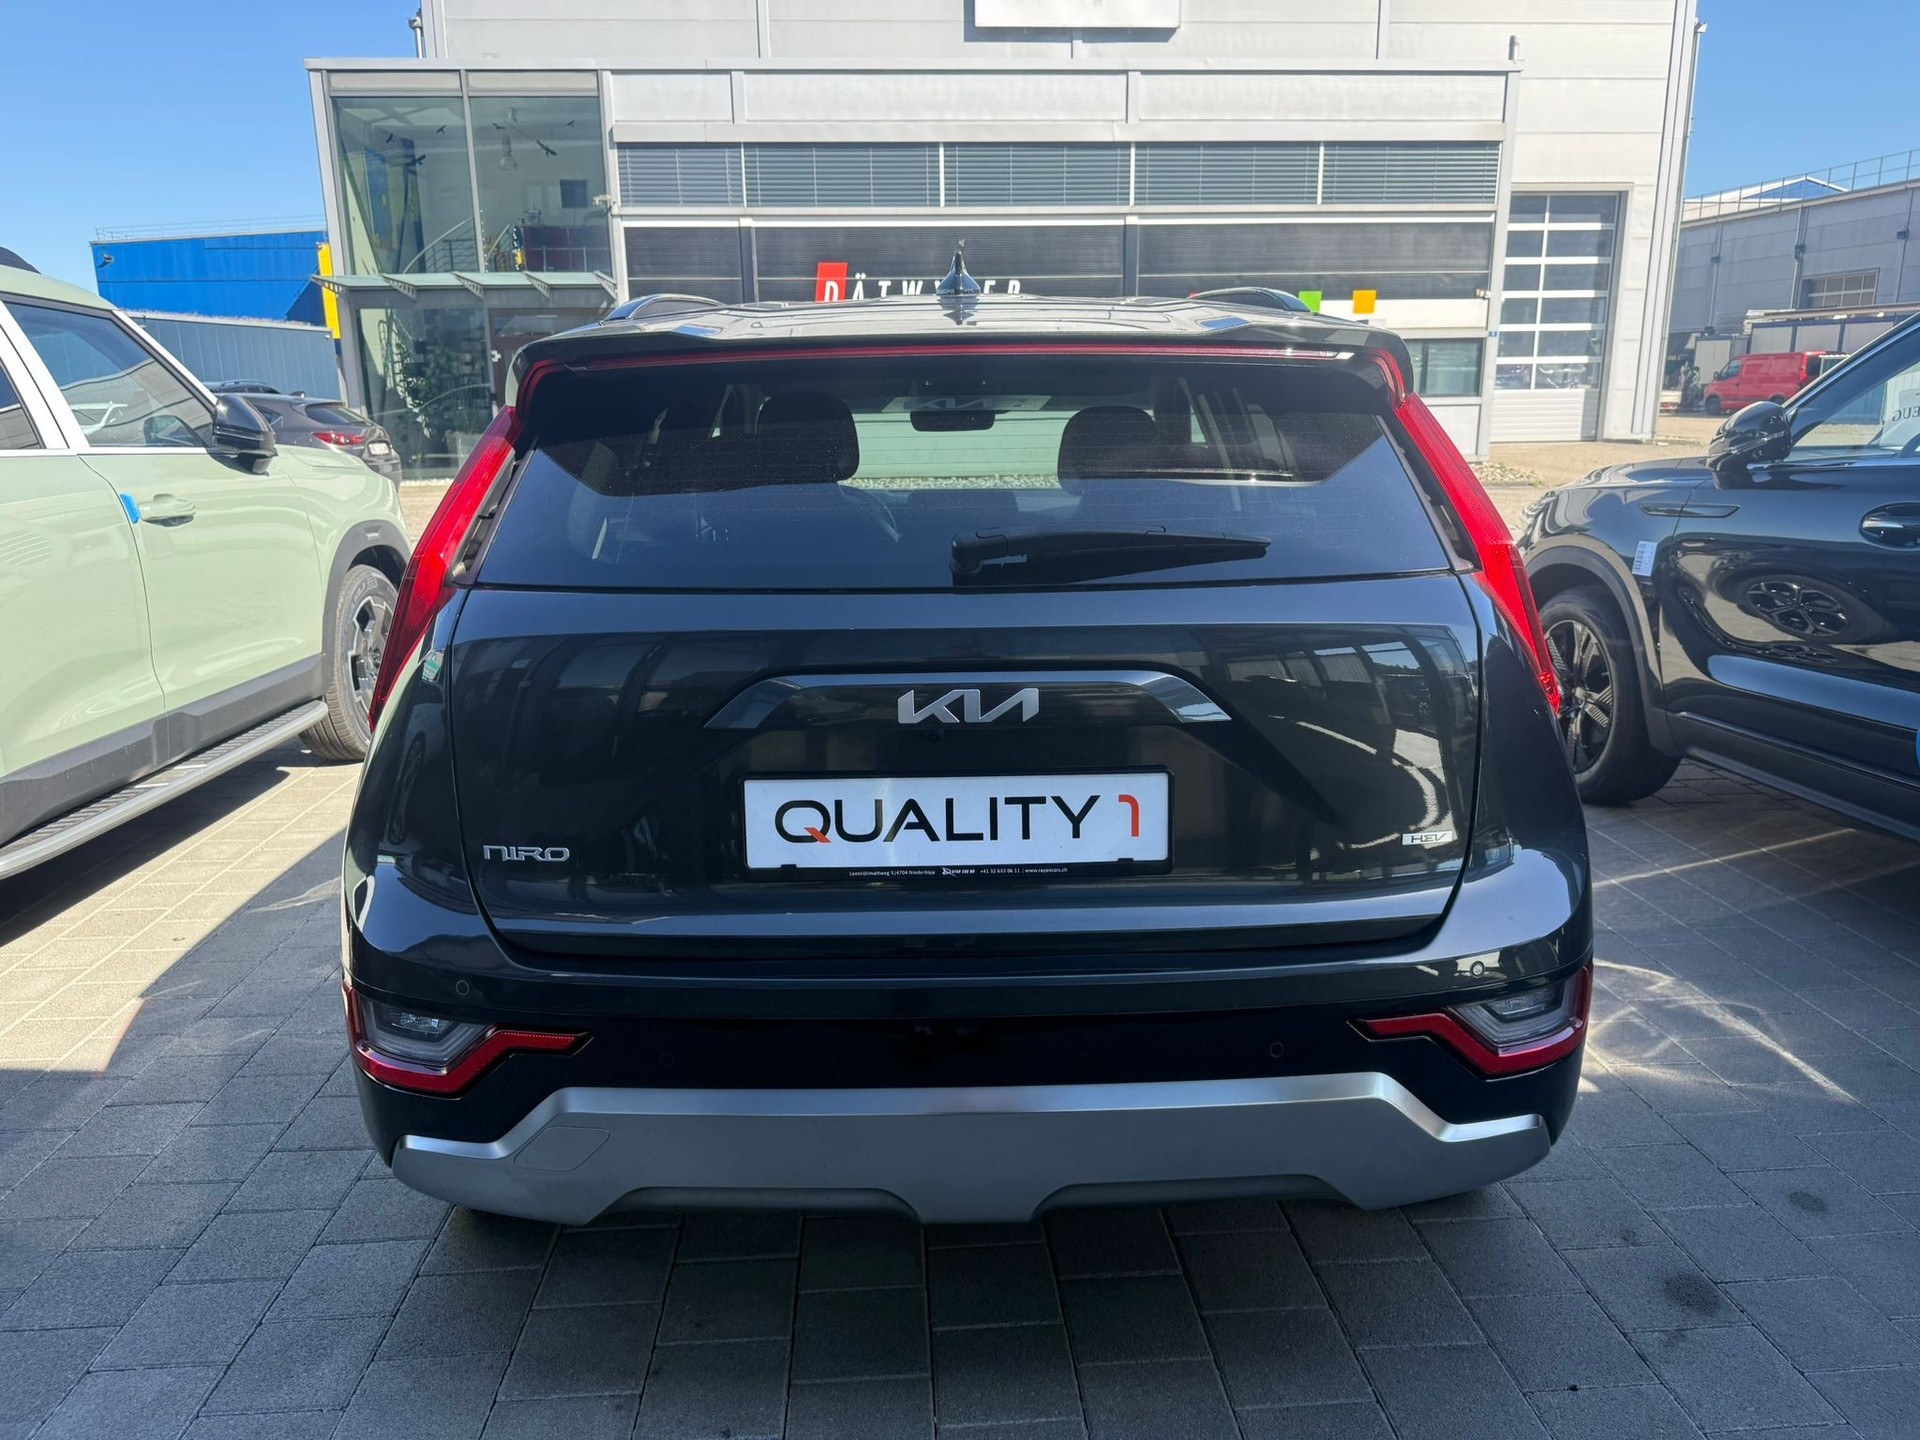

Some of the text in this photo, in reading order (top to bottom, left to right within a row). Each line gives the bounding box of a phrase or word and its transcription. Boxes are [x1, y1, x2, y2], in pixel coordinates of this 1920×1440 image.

[897, 687, 1040, 725] KIA
[774, 794, 1140, 844] QUALITY 1
[1410, 832, 1448, 844] HEV
[482, 844, 571, 862] NIRO
